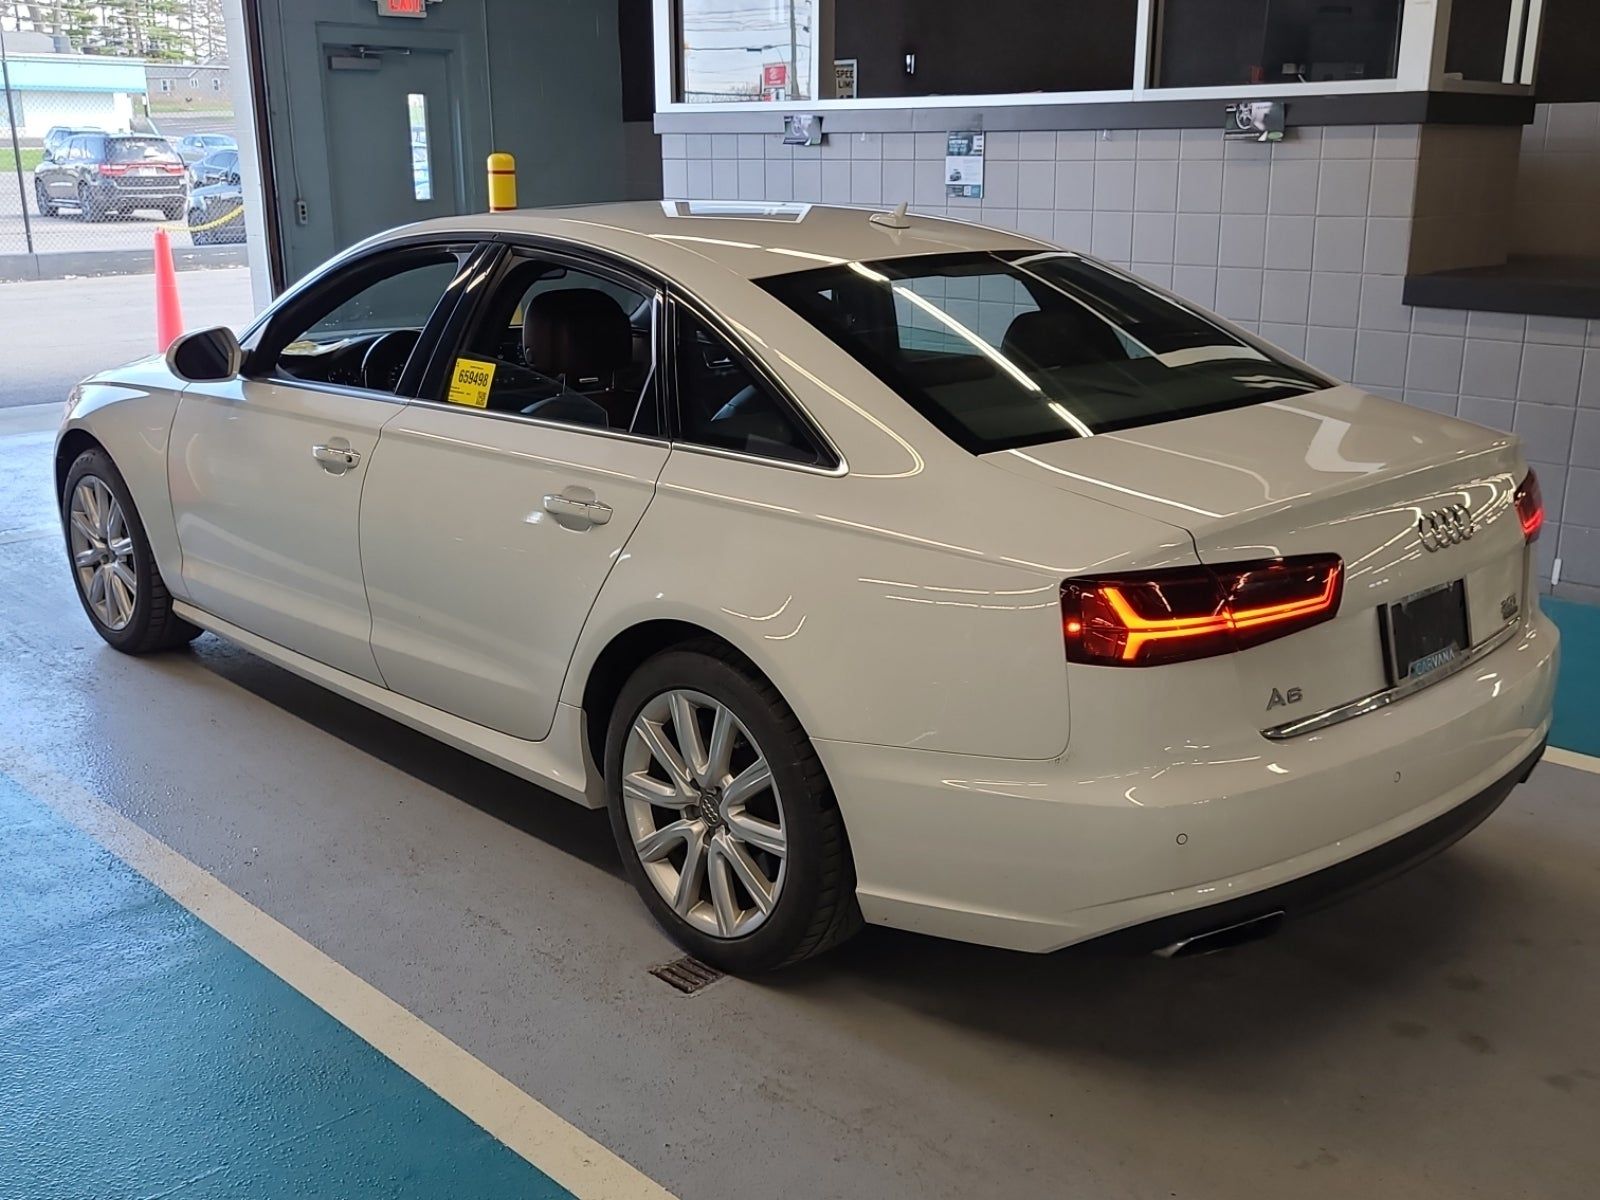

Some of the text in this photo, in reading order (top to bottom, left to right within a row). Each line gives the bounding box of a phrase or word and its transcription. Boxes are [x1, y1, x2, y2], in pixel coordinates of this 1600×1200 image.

[836, 69, 854, 79] SPEE
[458, 369, 489, 387] 659498
[1415, 648, 1455, 675] CARVANA
[1266, 687, 1303, 711] A6
